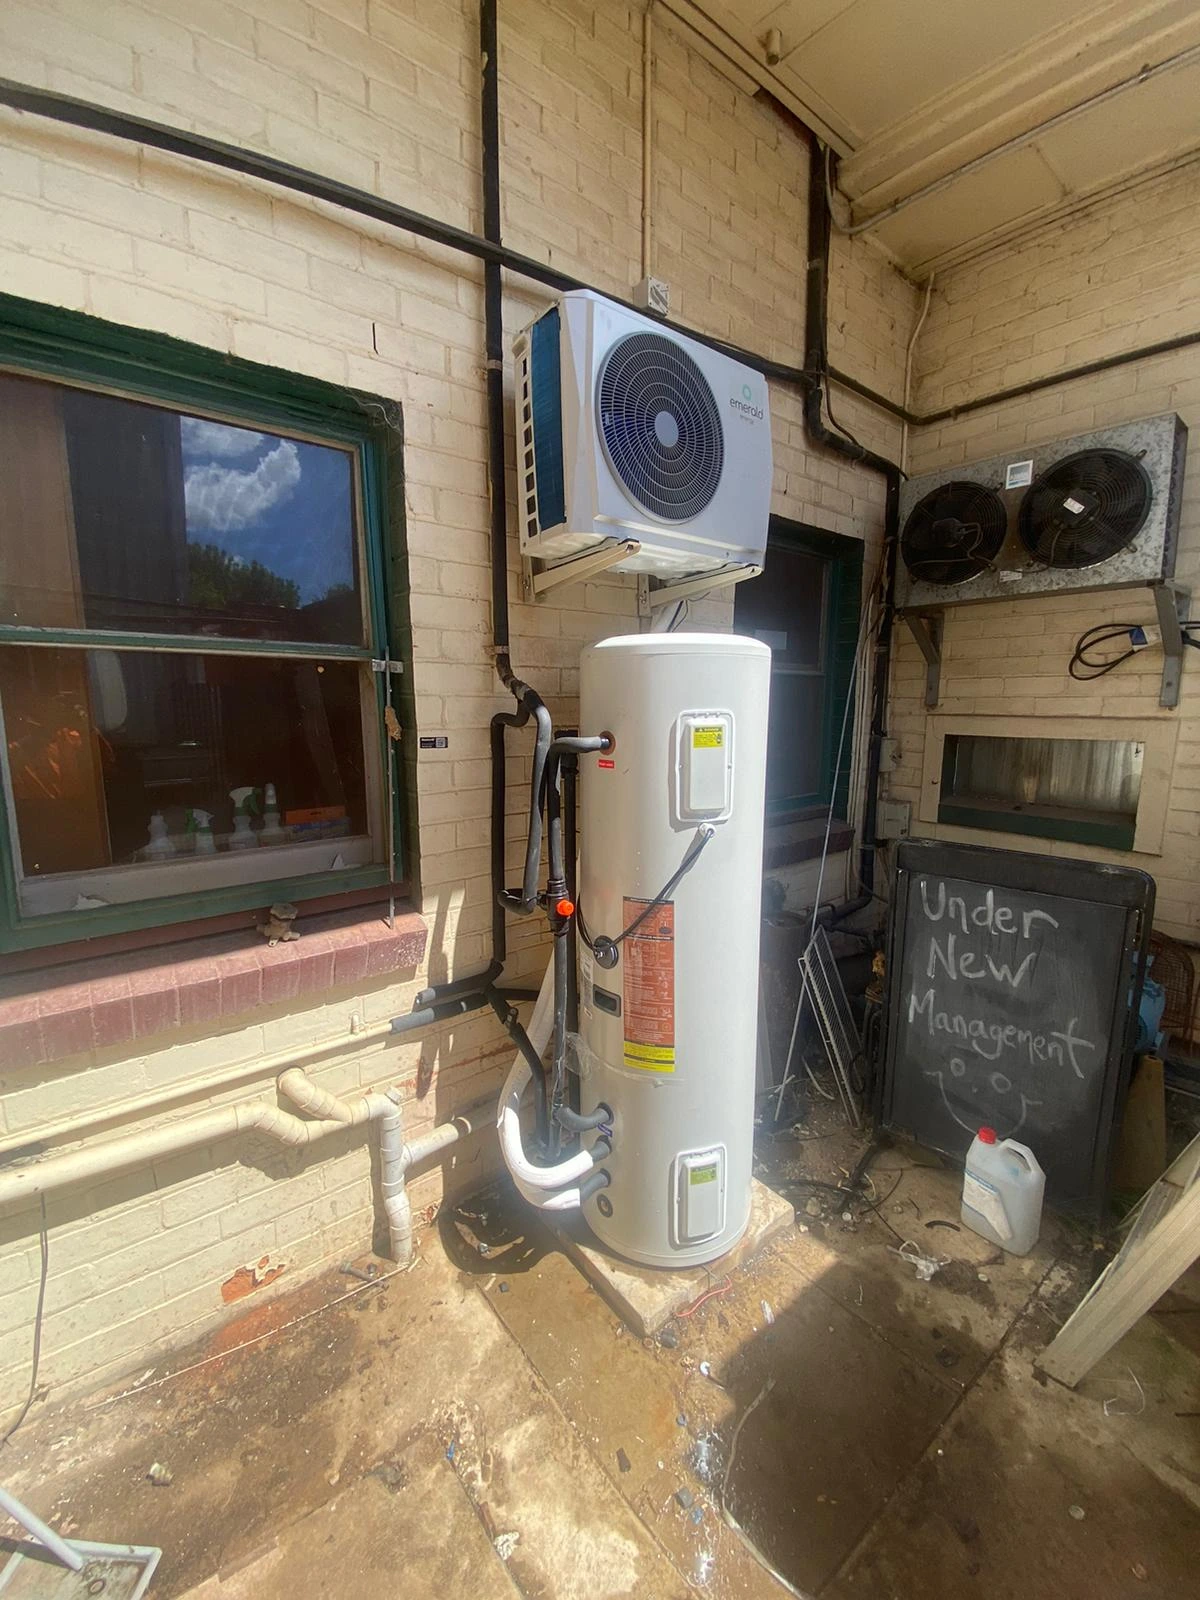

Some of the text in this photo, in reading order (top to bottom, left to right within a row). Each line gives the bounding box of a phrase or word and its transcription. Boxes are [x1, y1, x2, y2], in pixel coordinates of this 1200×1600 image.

[729, 397, 764, 420] emerald
[920, 880, 1060, 938] Under
[926, 932, 1037, 988] New
[908, 988, 1096, 1079] Management
